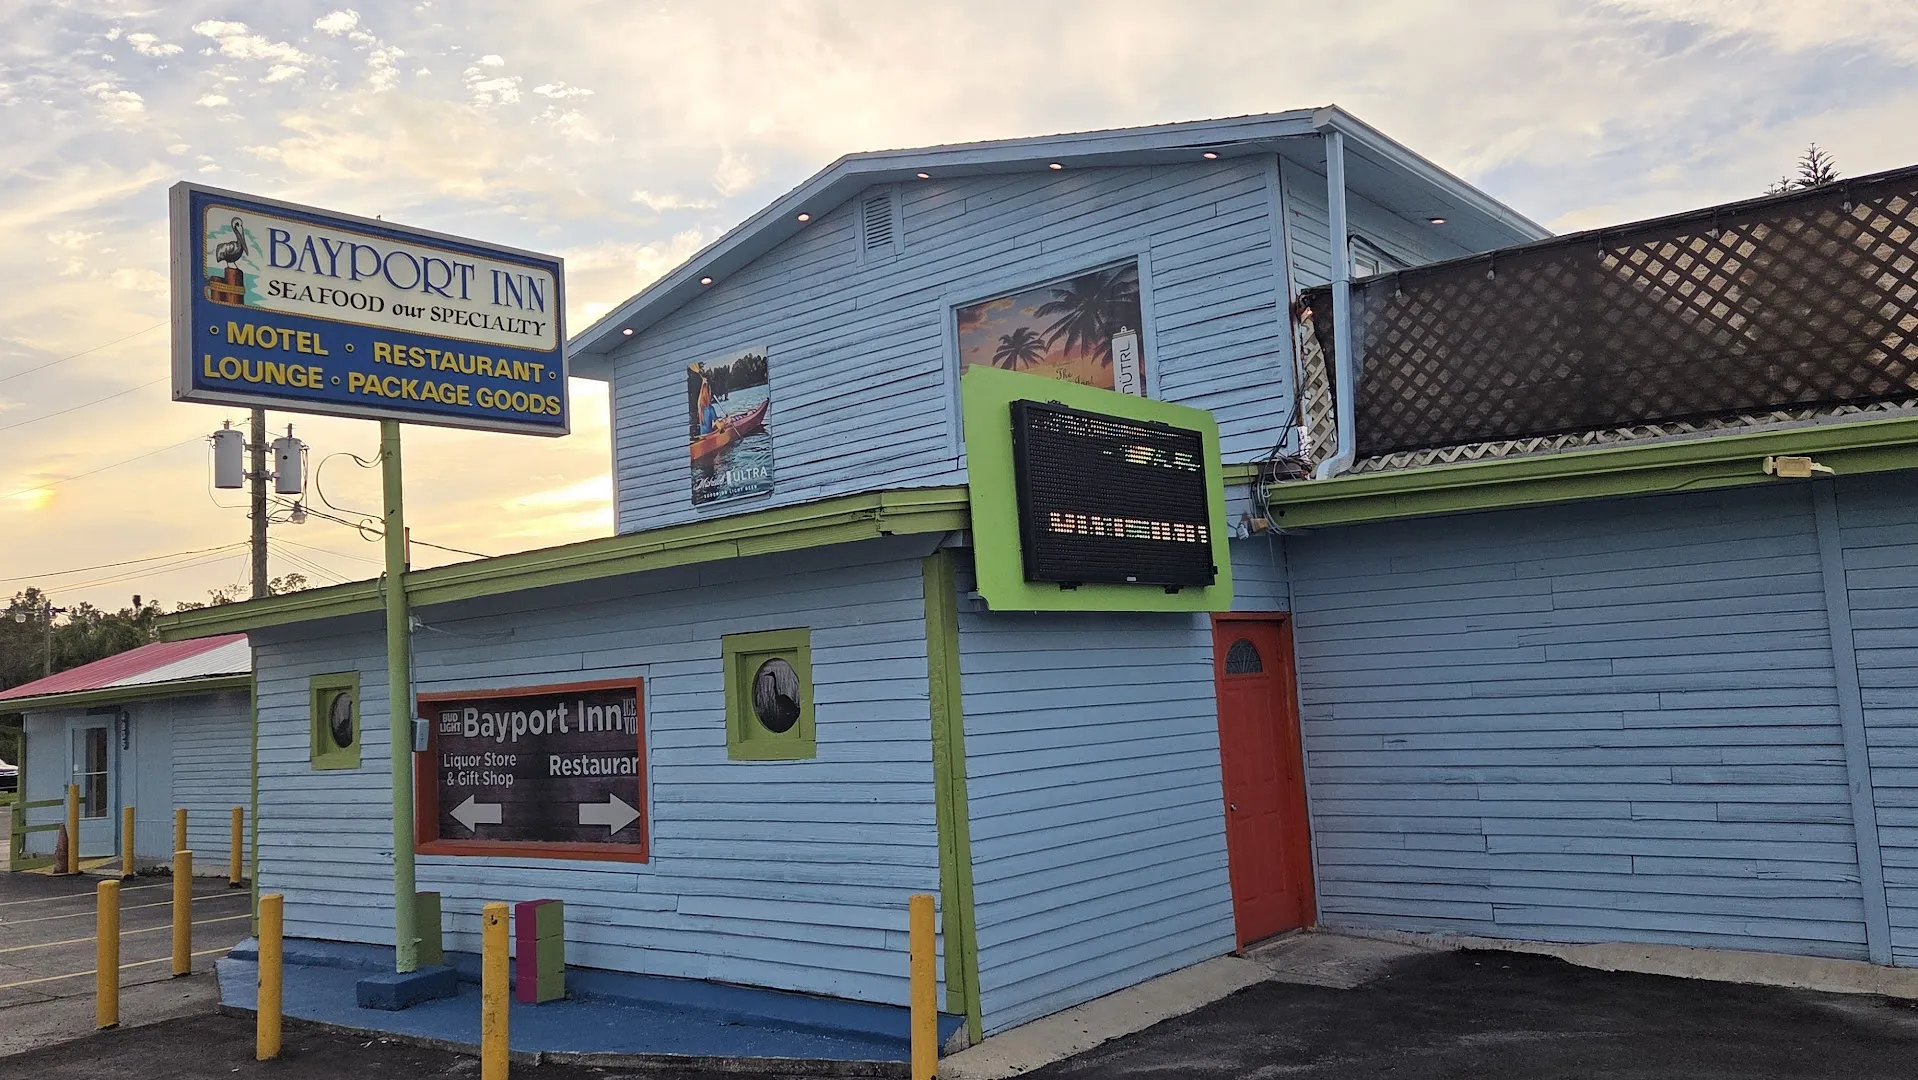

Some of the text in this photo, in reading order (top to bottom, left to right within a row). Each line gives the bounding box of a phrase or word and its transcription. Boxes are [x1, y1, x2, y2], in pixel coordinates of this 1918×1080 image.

[267, 228, 545, 313] BAYPORT INN
[267, 280, 546, 336] SEAFOOD our SPECIALTY
[227, 321, 545, 383] MOTEL RESTAURANT
[204, 354, 561, 415] LOUNGE PACKAGE GOODS
[733, 466, 768, 482] ULTRA
[440, 722, 461, 733] LIGHT
[442, 713, 458, 723] BUD
[463, 700, 622, 743] Bayport Inn
[443, 752, 517, 770] Liquor Store
[446, 770, 514, 788] & Gift Shop
